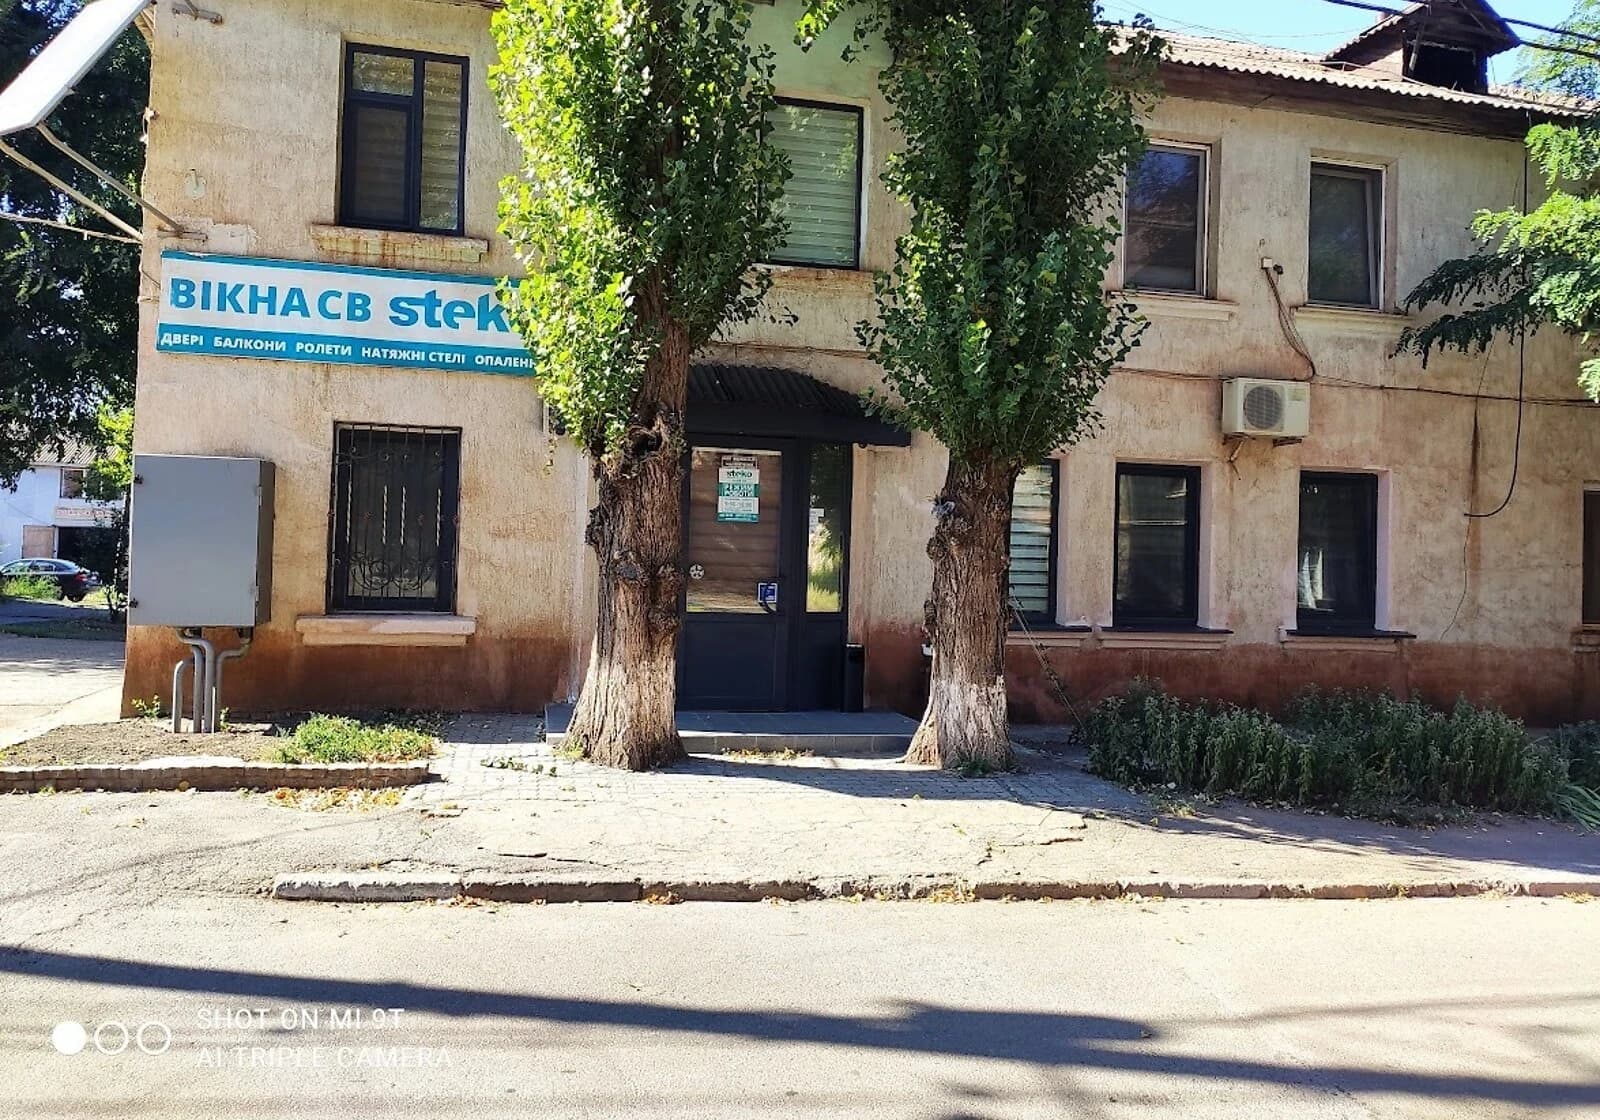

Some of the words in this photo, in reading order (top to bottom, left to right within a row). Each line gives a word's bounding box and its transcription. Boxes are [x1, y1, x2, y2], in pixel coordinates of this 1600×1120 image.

[170, 278, 310, 318] ВІКНА
[317, 290, 371, 322] СВ
[389, 289, 510, 333] stek
[160, 332, 204, 346] ДВЕРІ
[213, 336, 286, 352] БАЛКОНИ
[295, 341, 352, 356] РОЛЕТИ
[361, 346, 426, 361] НАТЯЖНІ
[428, 351, 466, 364] СТЕЛІ
[474, 354, 537, 369] ОПАЛЕНН
